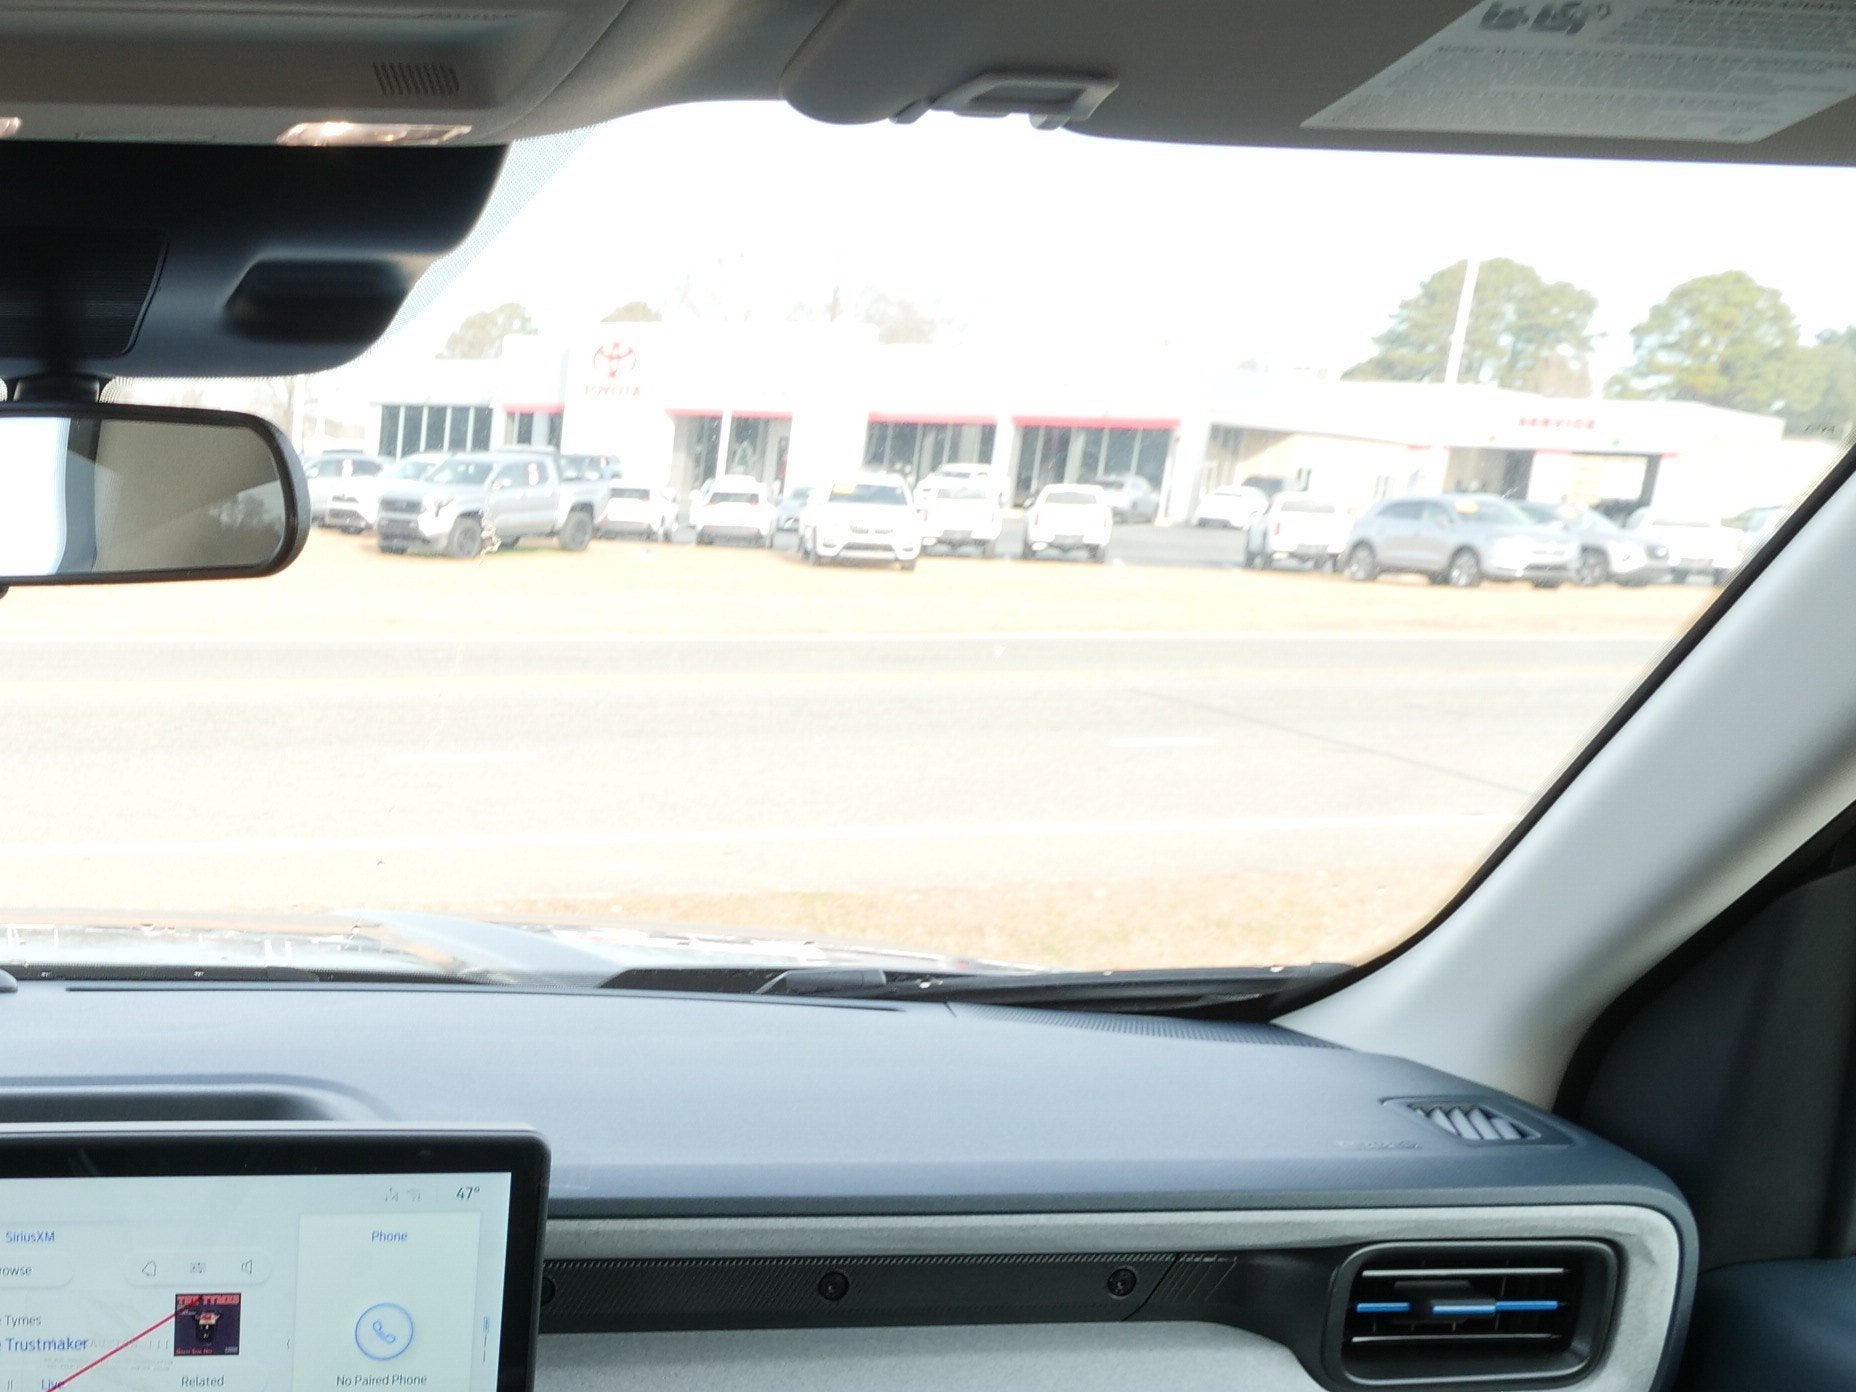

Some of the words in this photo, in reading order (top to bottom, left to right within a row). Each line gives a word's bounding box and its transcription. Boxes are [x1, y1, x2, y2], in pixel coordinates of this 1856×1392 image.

[5, 1230, 55, 1244] SiriusXM
[371, 1230, 408, 1243] Phone
[4, 1315, 42, 1329] Tymes
[5, 1336, 89, 1352] Trustmaker
[41, 1378, 64, 1391] Live
[181, 1375, 225, 1388] Related
[336, 1375, 351, 1387] No
[354, 1374, 389, 1387] Paired
[391, 1373, 427, 1386] Phone
